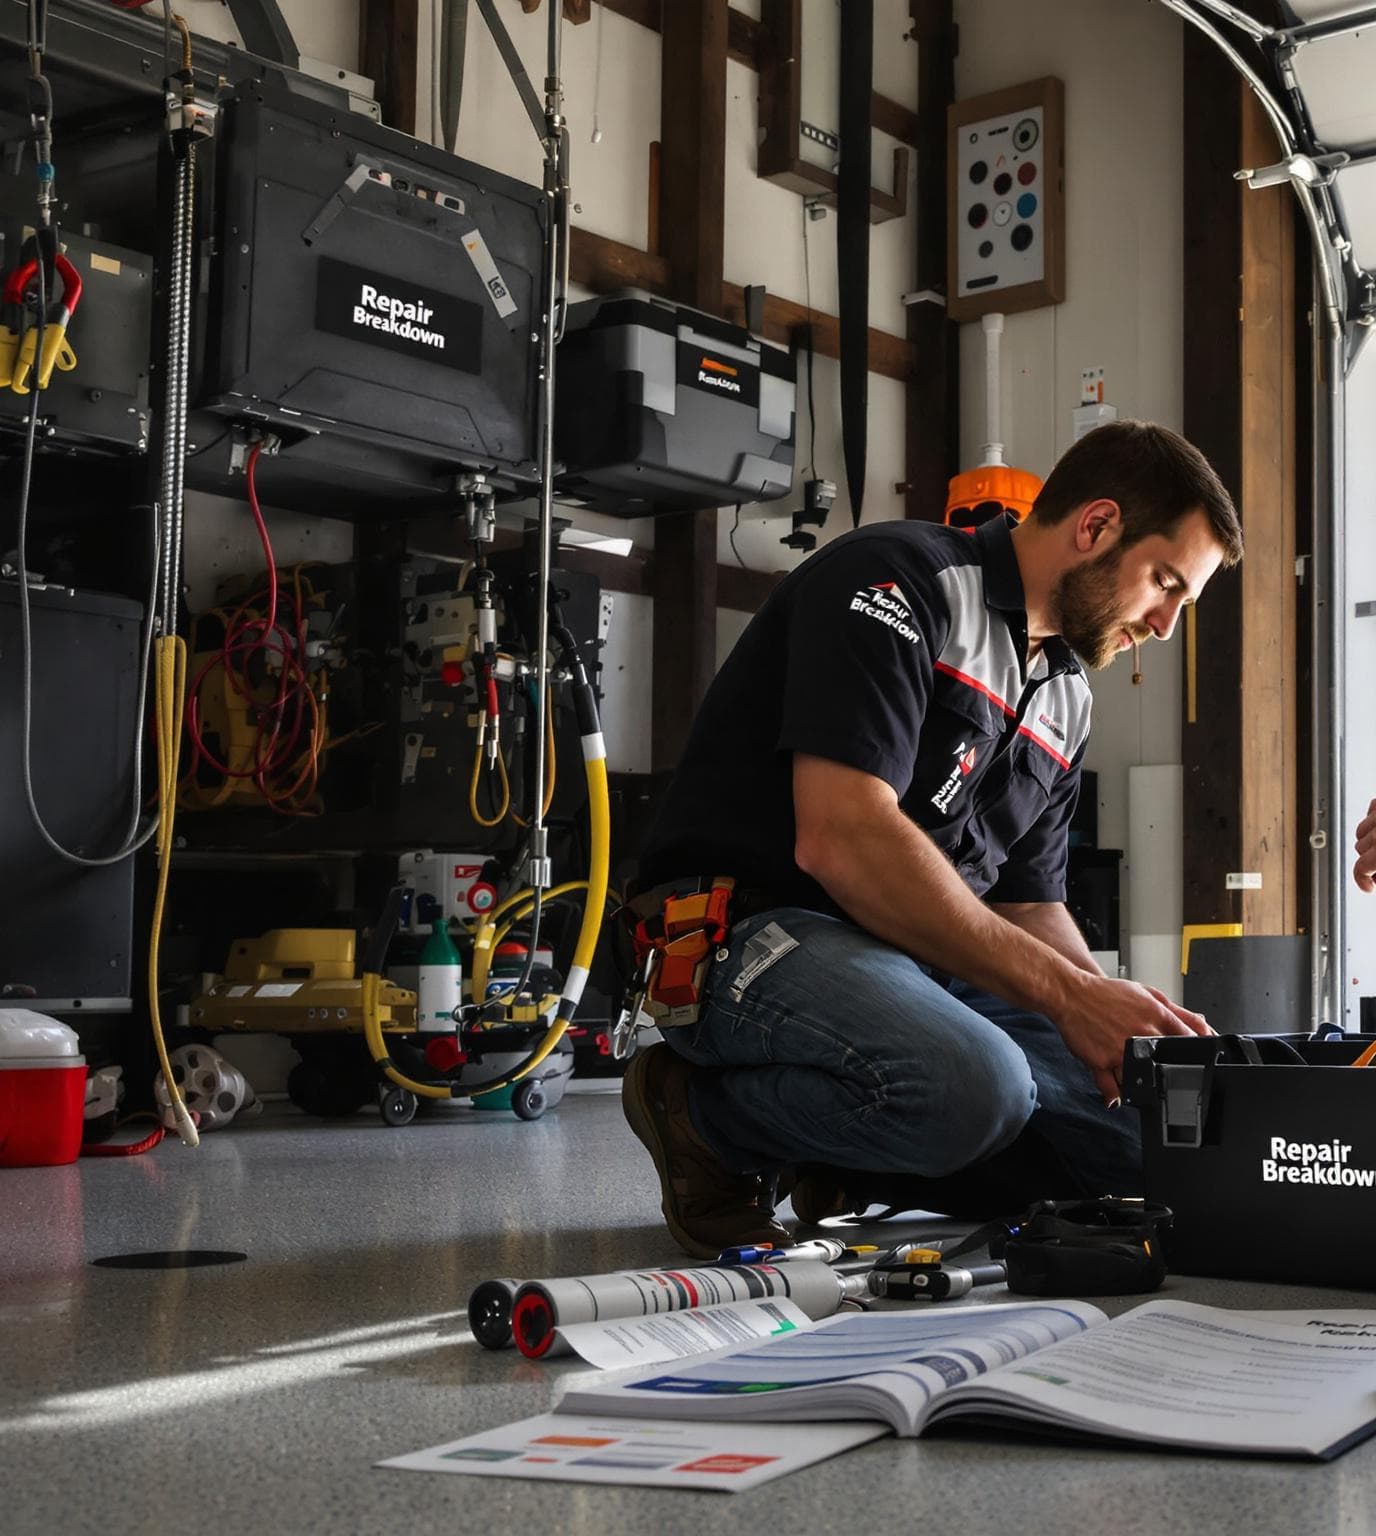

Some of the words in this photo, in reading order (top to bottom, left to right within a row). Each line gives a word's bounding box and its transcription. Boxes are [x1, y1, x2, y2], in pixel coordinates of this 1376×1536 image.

[361, 284, 434, 325] Repair
[353, 305, 445, 349] Breakdown
[1270, 1136, 1352, 1166] Repair
